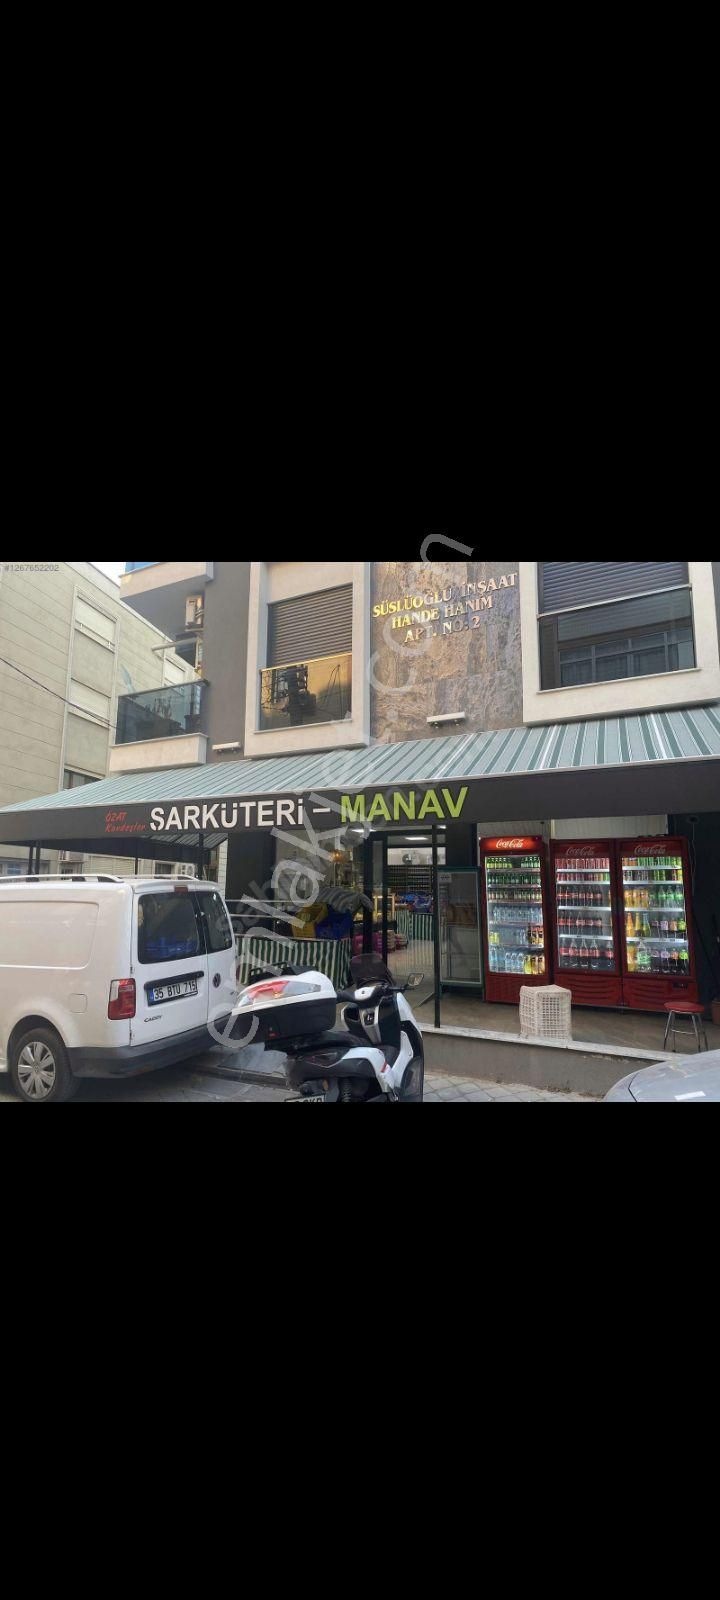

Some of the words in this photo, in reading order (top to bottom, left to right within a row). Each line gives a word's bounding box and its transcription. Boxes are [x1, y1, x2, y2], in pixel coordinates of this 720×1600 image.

[391, 607, 440, 629] HANDE
[444, 594, 494, 618] HANIM
[340, 786, 469, 823] MANAV
[153, 988, 164, 999] 35
[167, 985, 181, 997] BTU
